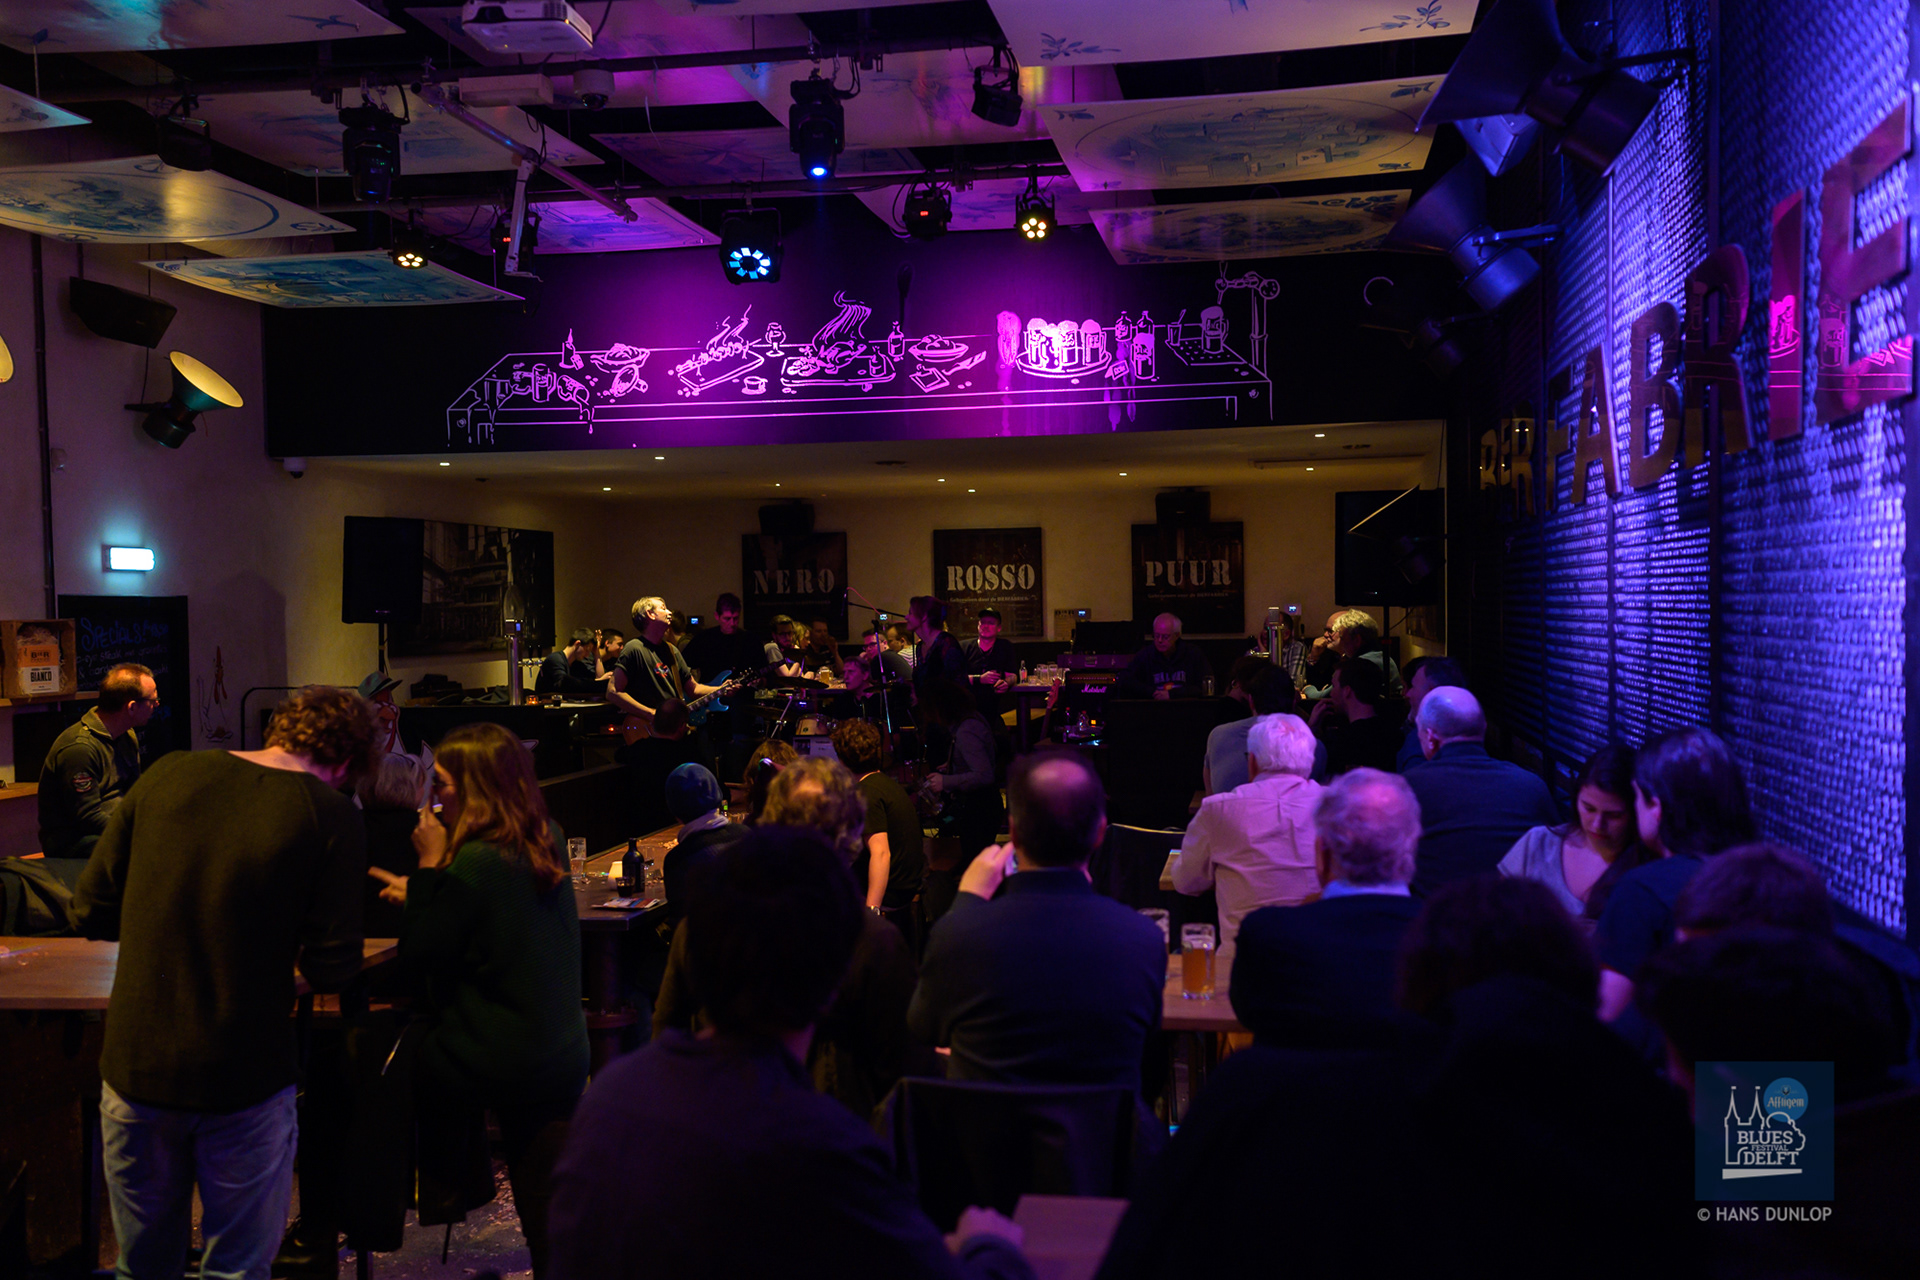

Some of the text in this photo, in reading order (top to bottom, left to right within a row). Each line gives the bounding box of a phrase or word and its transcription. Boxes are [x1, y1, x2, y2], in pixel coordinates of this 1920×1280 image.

[753, 568, 835, 595] NERO
[946, 563, 1036, 591] ROSSO
[1145, 559, 1232, 587] PUUR
[30, 671, 52, 682] BIANCO
